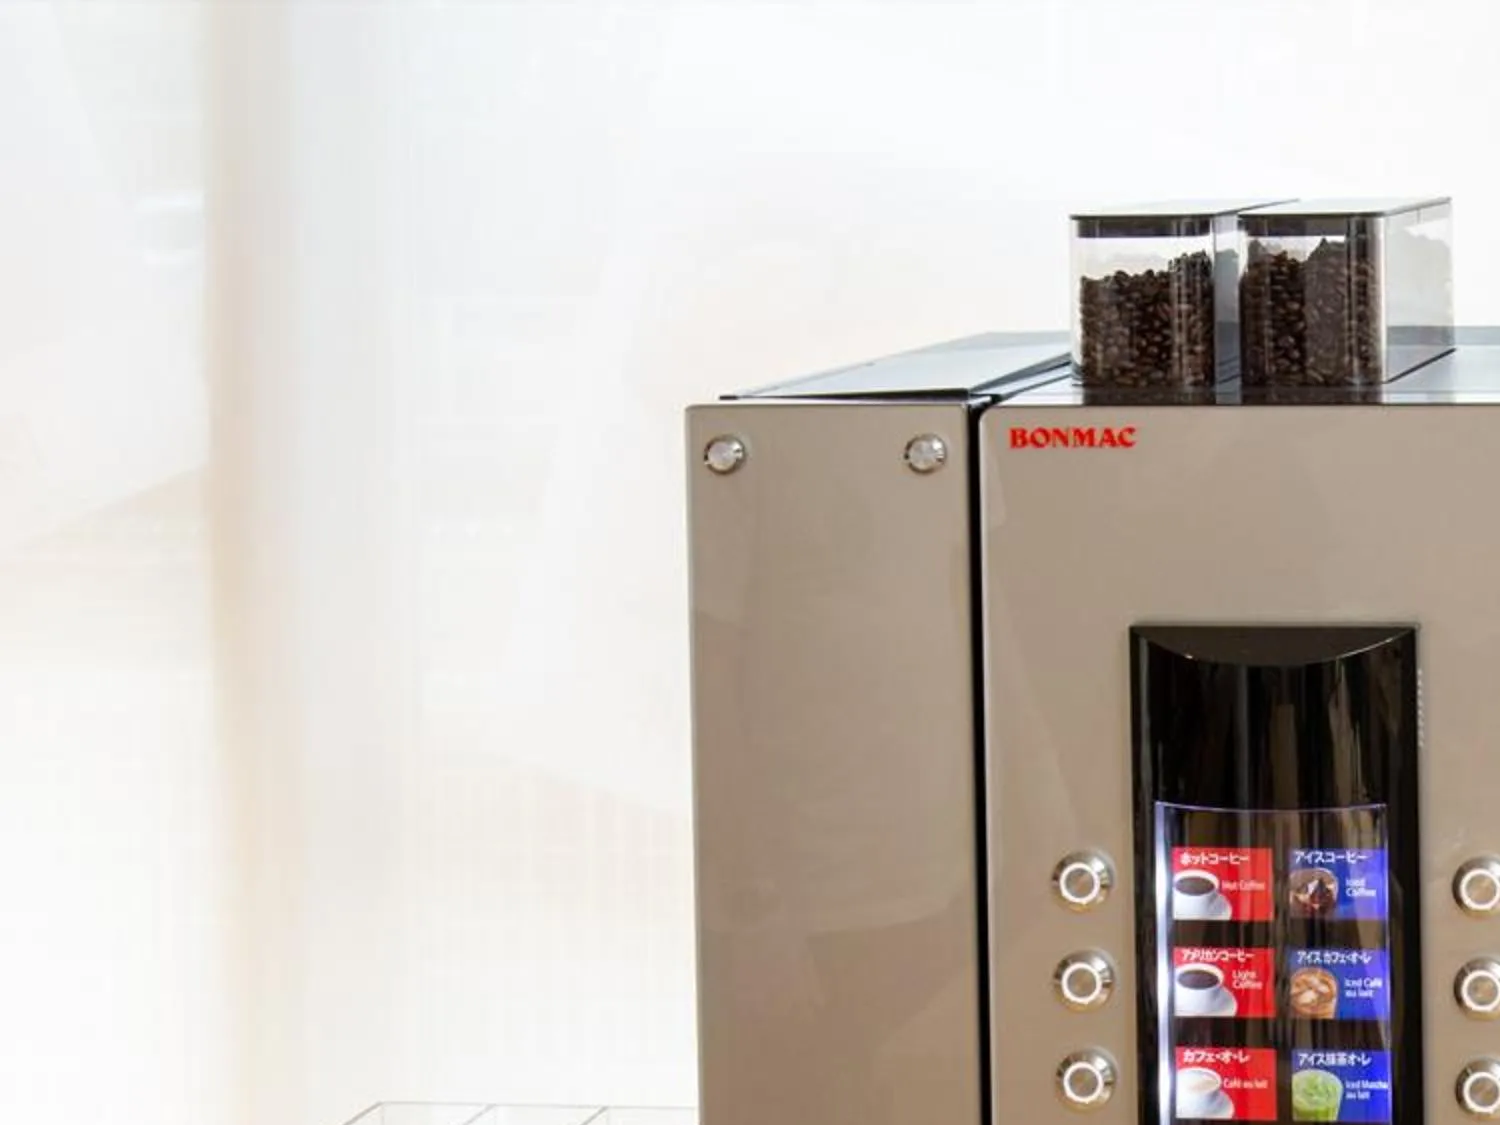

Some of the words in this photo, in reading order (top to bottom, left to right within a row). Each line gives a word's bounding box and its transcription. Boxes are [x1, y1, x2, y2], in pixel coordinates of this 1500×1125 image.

[1009, 427, 1137, 448] BONMAC
[1180, 852, 1249, 866] ホットコーヒー
[1294, 851, 1369, 864] アイスコーヒー
